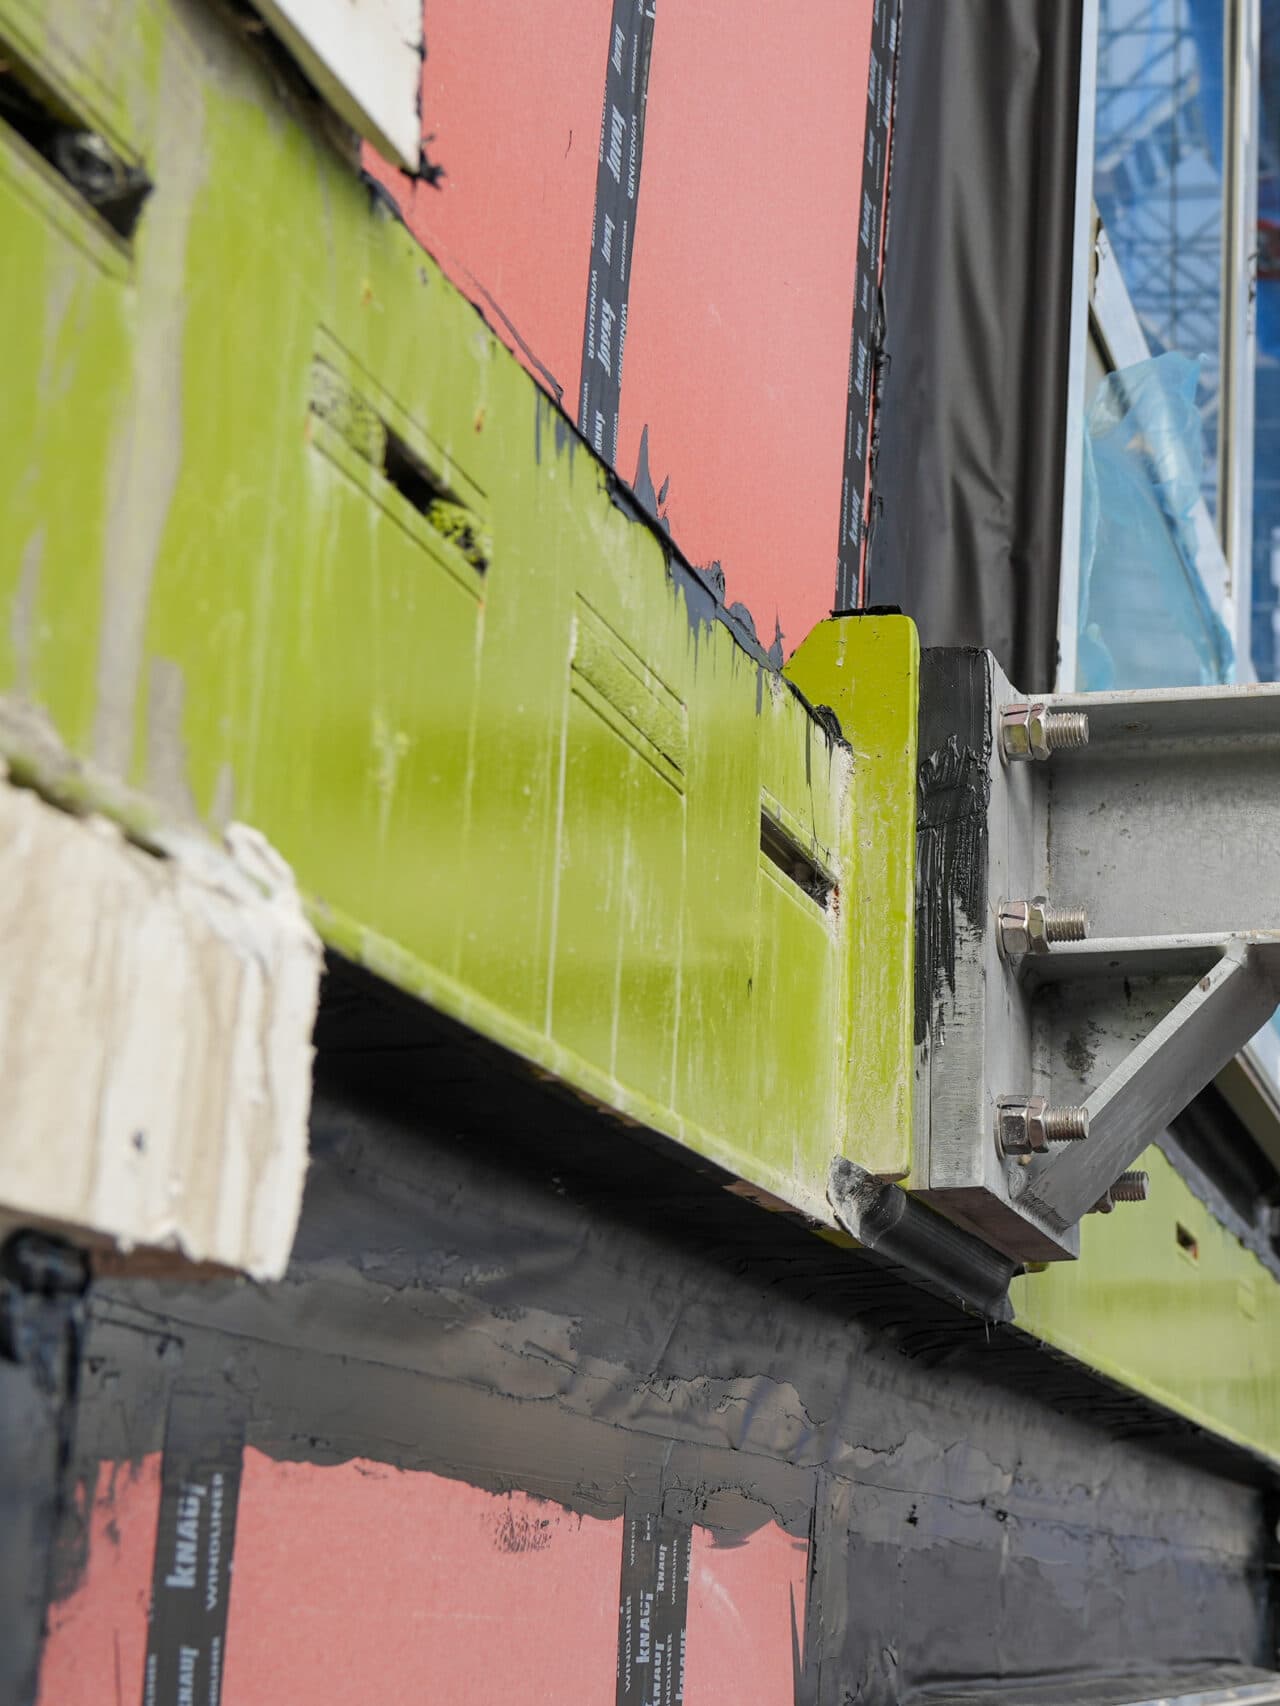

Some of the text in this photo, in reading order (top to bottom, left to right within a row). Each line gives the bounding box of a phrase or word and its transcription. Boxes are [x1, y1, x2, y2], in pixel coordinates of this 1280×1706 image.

[626, 113, 638, 200] WINDLINER
[587, 269, 598, 359] WINDLINER
[206, 1473, 223, 1611] WINDLINER
[624, 1595, 632, 1693] WINDLINER
